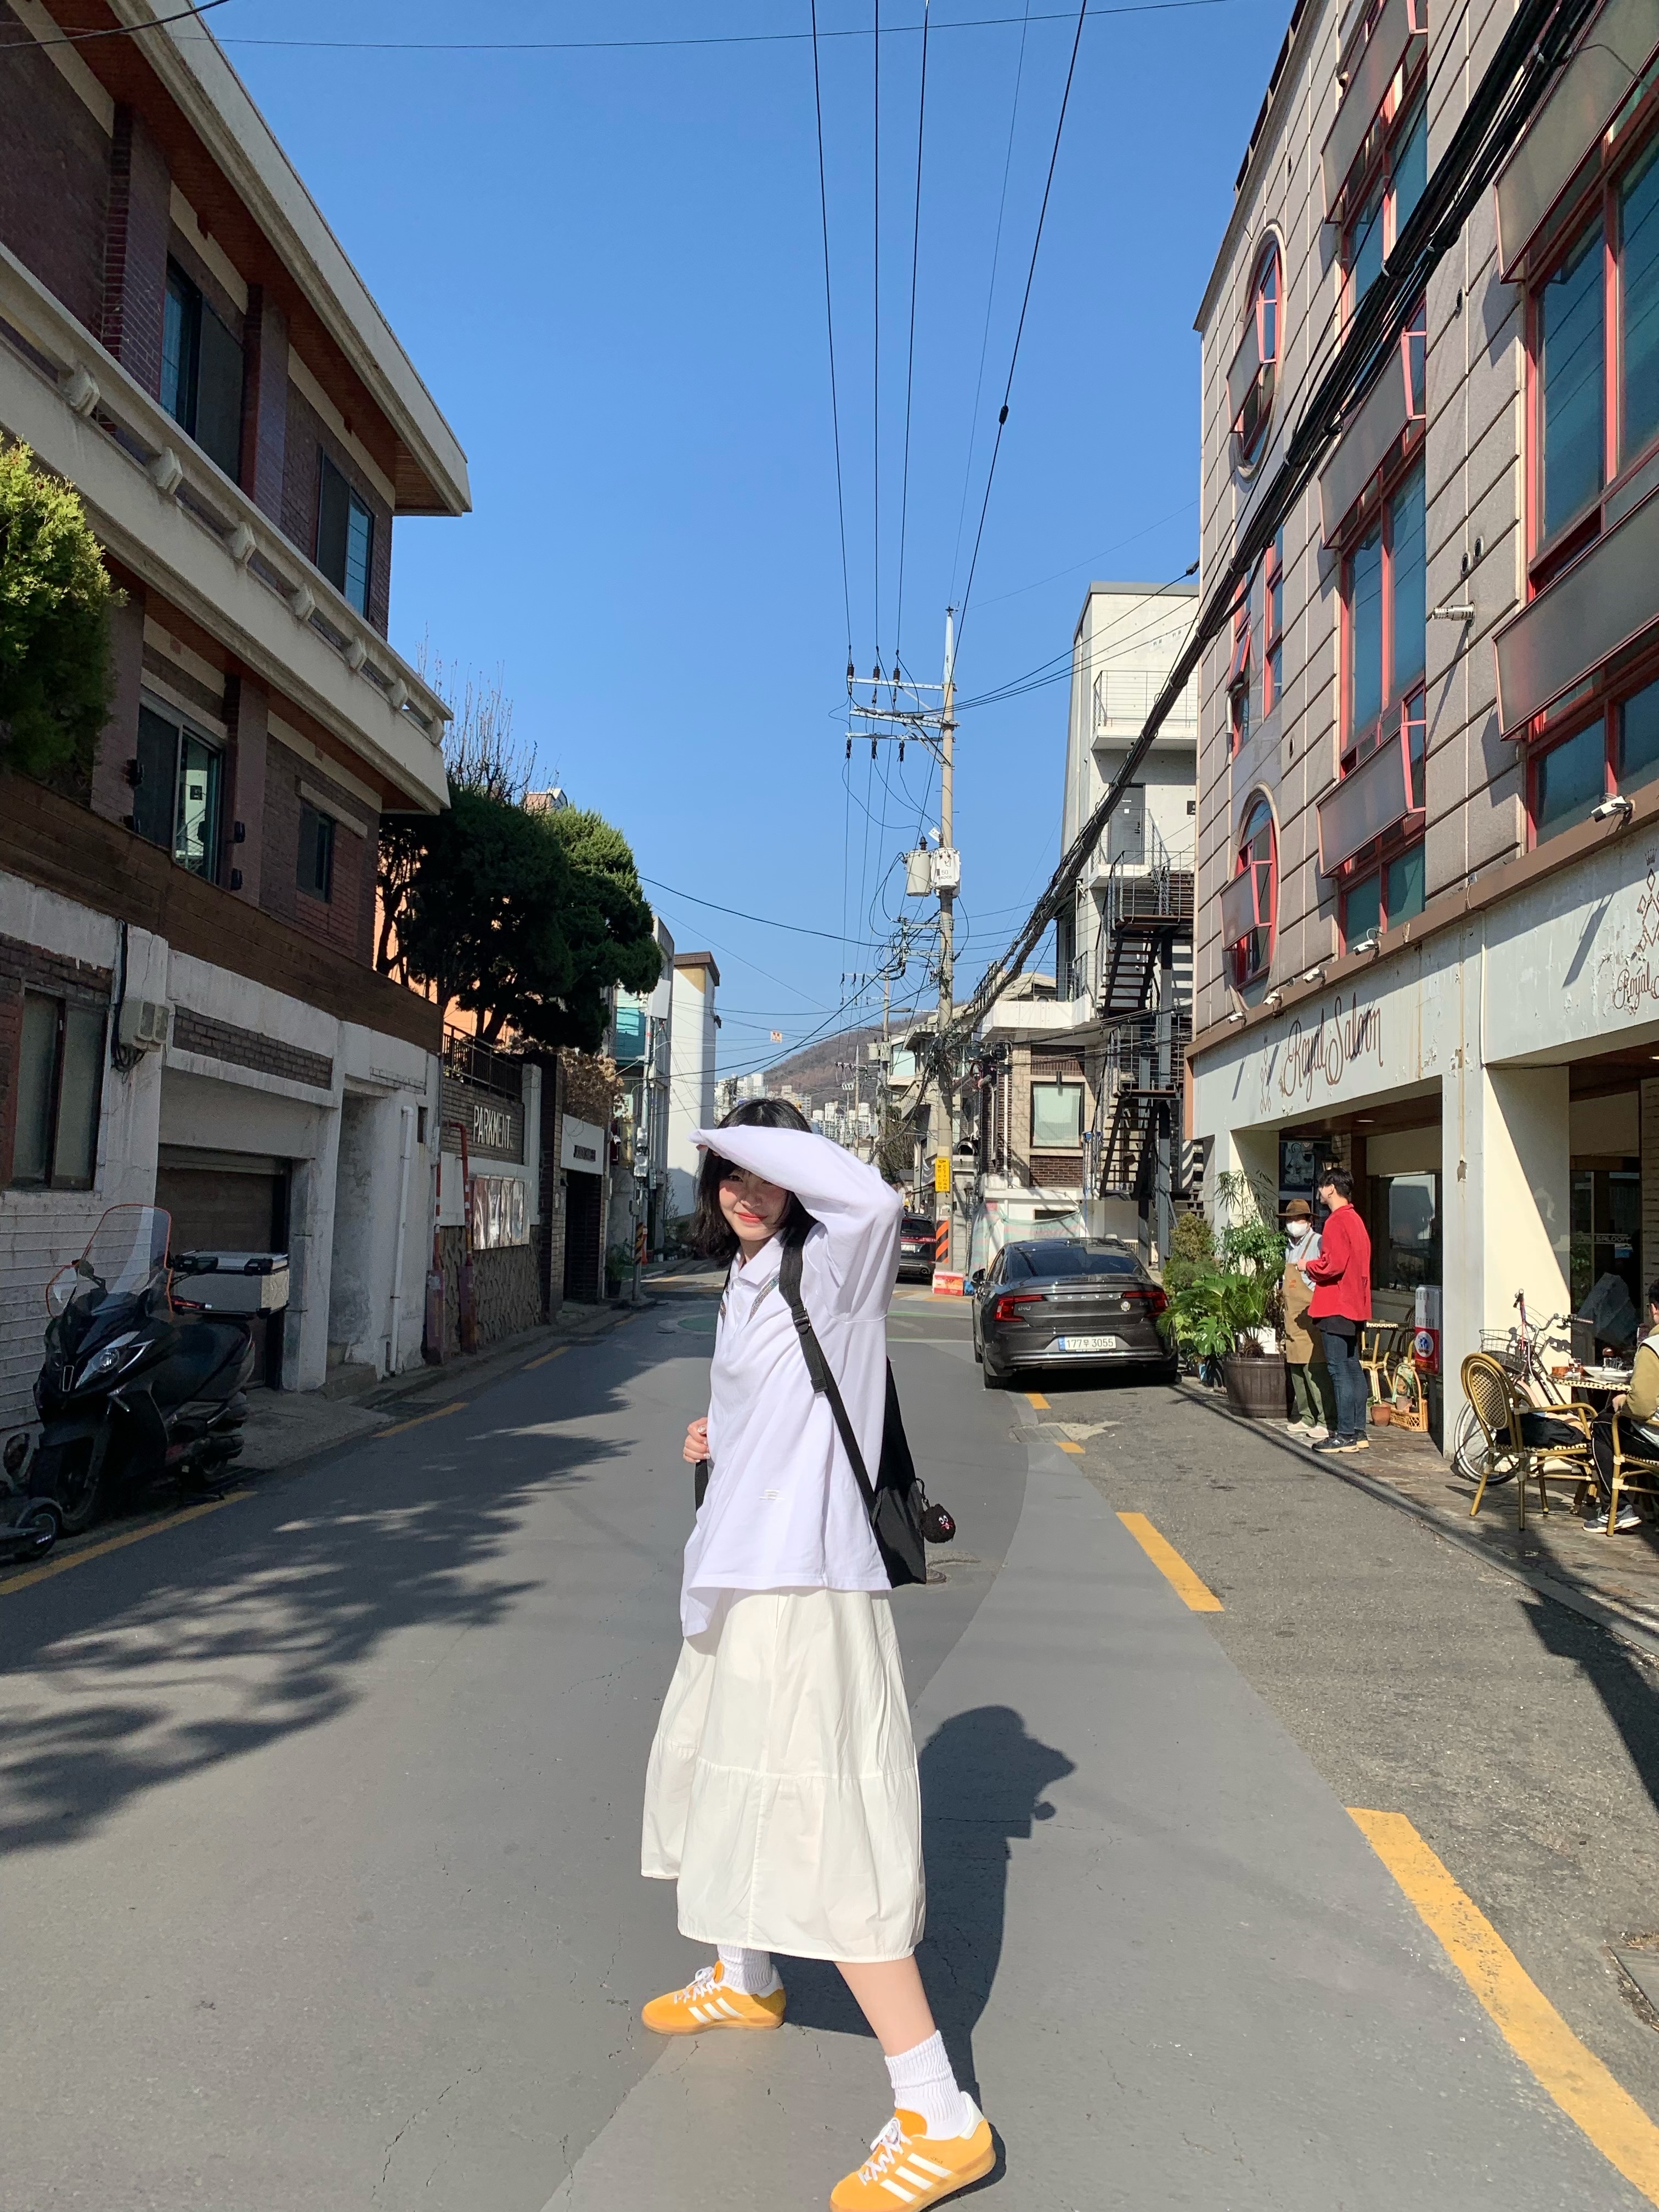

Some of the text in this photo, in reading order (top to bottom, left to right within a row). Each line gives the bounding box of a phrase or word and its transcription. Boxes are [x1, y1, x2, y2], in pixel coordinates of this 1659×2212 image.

[1614, 962, 1651, 1009] Royal
[1284, 992, 1384, 1103] Royal Saloon
[1066, 1339, 1114, 1348] 177무 3055
